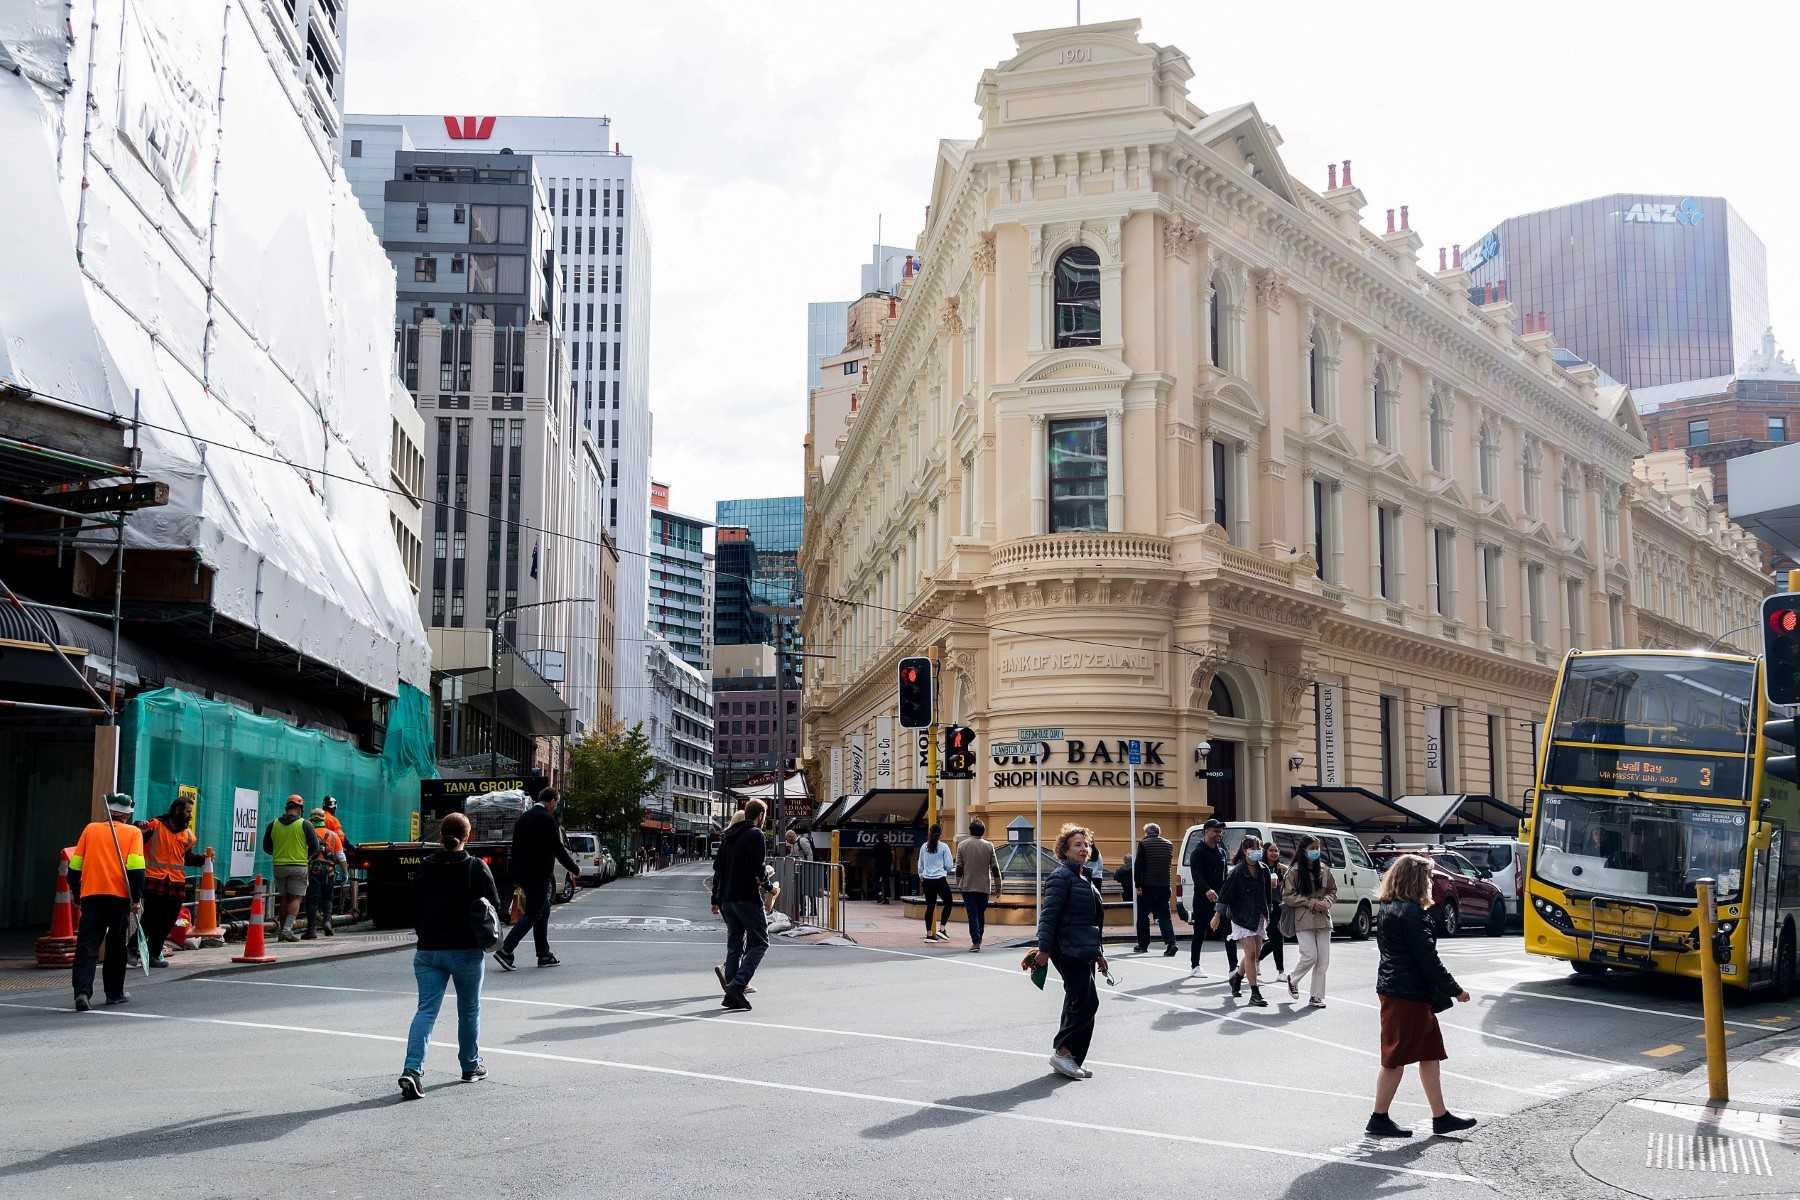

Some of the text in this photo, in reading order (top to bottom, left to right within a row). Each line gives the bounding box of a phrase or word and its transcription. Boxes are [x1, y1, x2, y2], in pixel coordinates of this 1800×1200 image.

[1058, 48, 1092, 64] 1901
[1624, 203, 1677, 222] ANZ
[1000, 653, 1151, 673] BANK OF NEW ZEALAND
[878, 738, 890, 749] Co
[1324, 688, 1335, 783] SMITH THE GROCER
[1066, 740, 1165, 765] BANK
[1427, 734, 1438, 769] RUBY
[878, 758, 890, 776] Sills
[1616, 760, 1662, 774] Lyall Bay
[993, 770, 1165, 787] SHOPPING ARCADE
[1700, 767, 1711, 786] 3
[444, 780, 524, 792] TANA GROUP
[235, 808, 257, 828] McKEE
[399, 857, 421, 865] TANA
